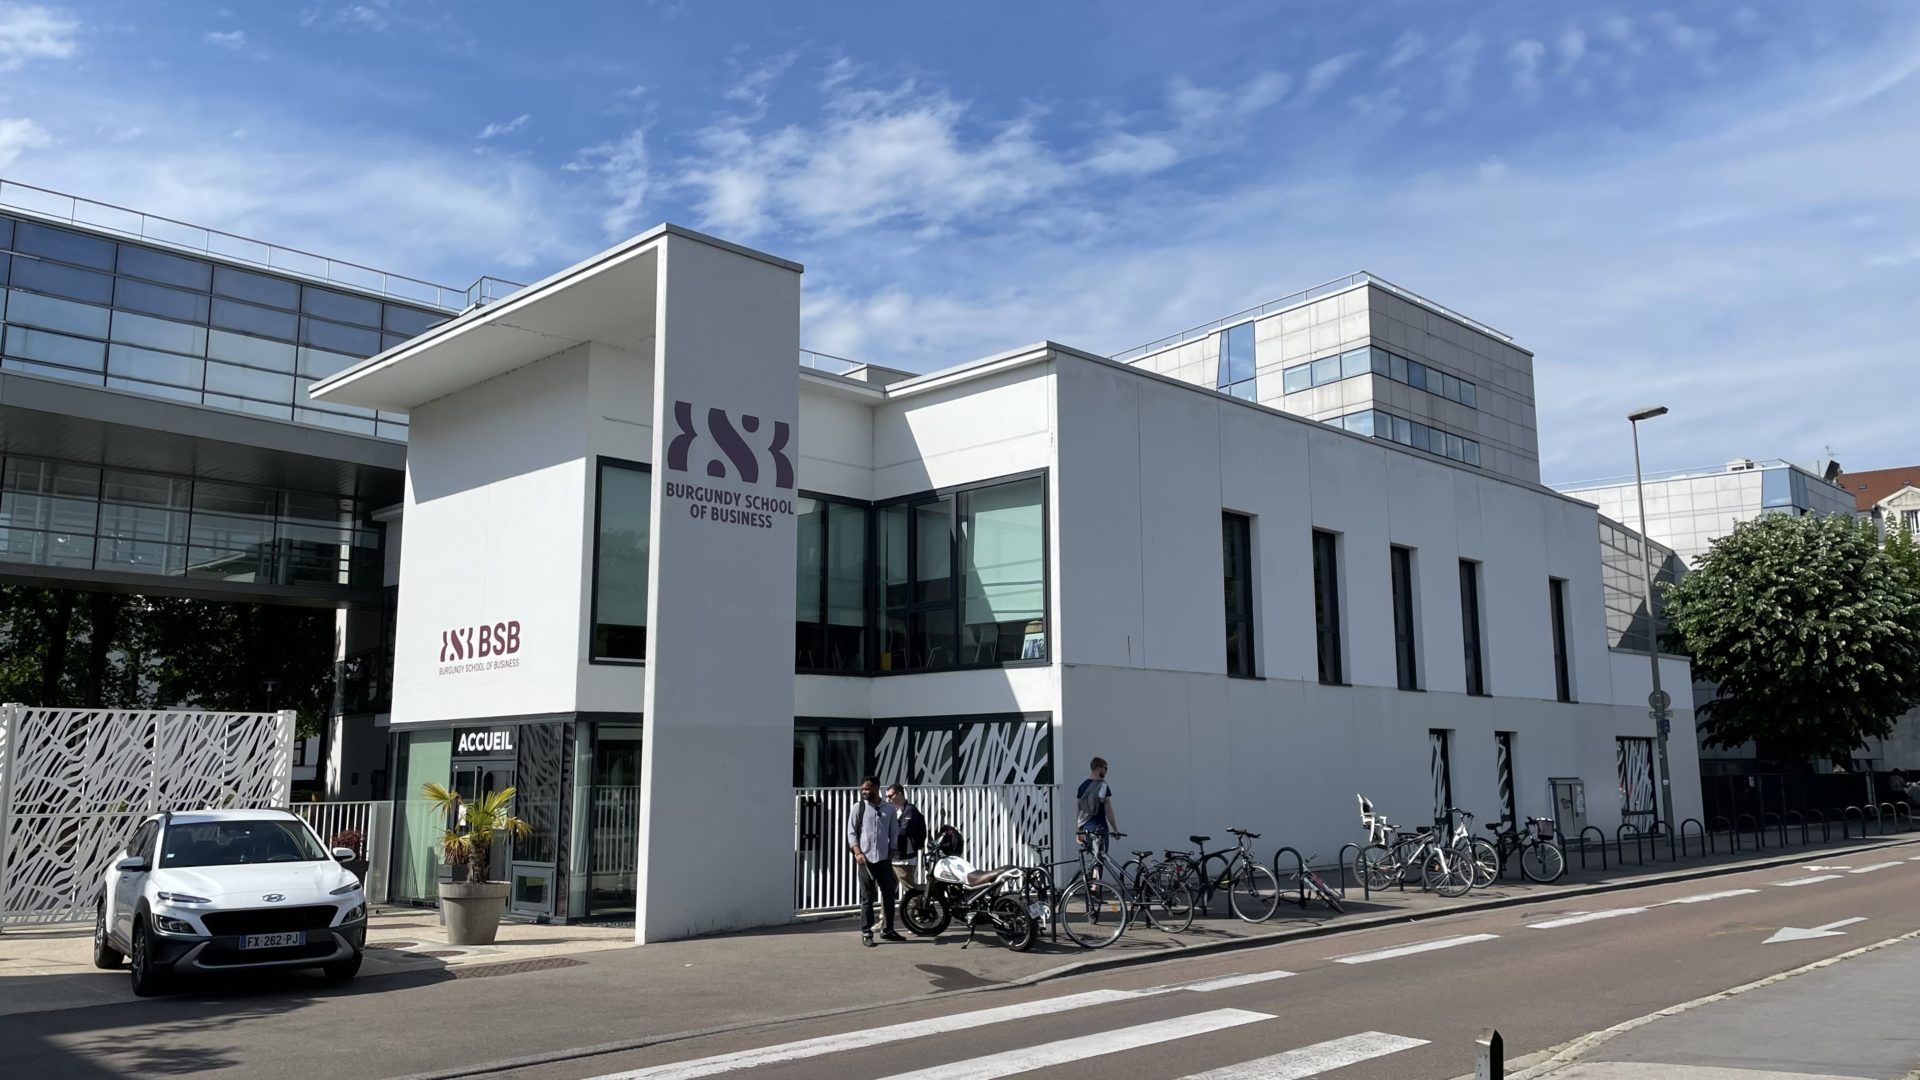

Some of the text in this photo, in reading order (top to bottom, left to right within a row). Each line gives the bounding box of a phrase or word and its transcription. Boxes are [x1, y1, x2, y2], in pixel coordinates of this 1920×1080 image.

[666, 482, 794, 515] BURGUNDY SCHOOL
[690, 504, 773, 529] OF BUSINESS
[478, 620, 521, 657] BSB
[439, 658, 520, 676] BURGUNDY SCHOOL OF BUSINESS
[458, 731, 513, 752] ACCUEIL
